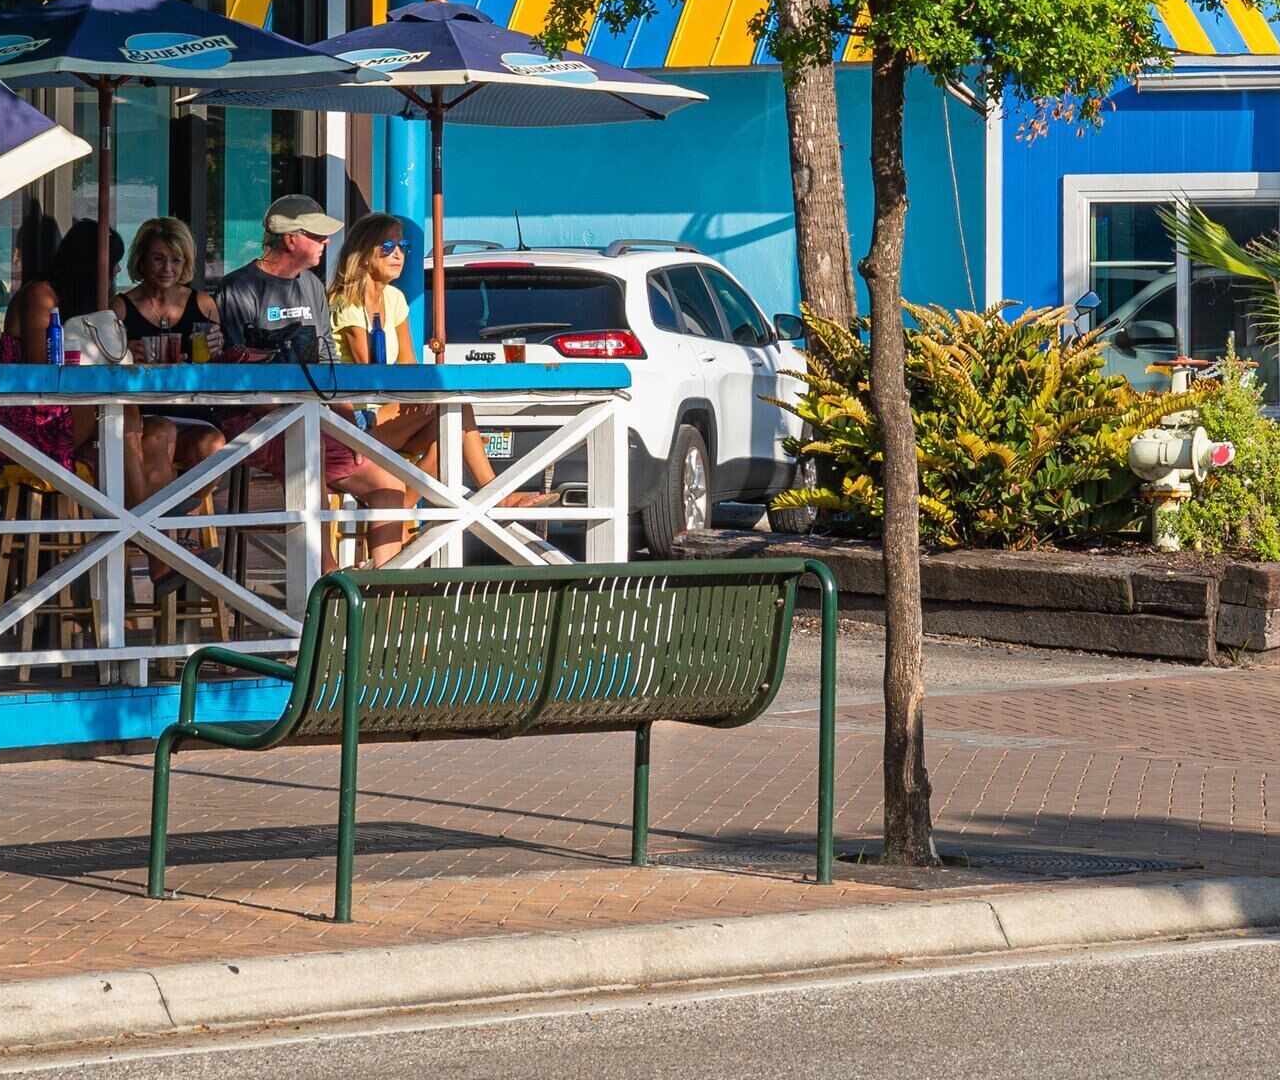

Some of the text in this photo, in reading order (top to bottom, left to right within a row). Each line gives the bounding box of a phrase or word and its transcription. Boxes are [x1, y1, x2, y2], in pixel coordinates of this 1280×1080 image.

[128, 37, 229, 61] BLUE MOON
[365, 53, 424, 66] MOON
[465, 350, 496, 363] Jeep
